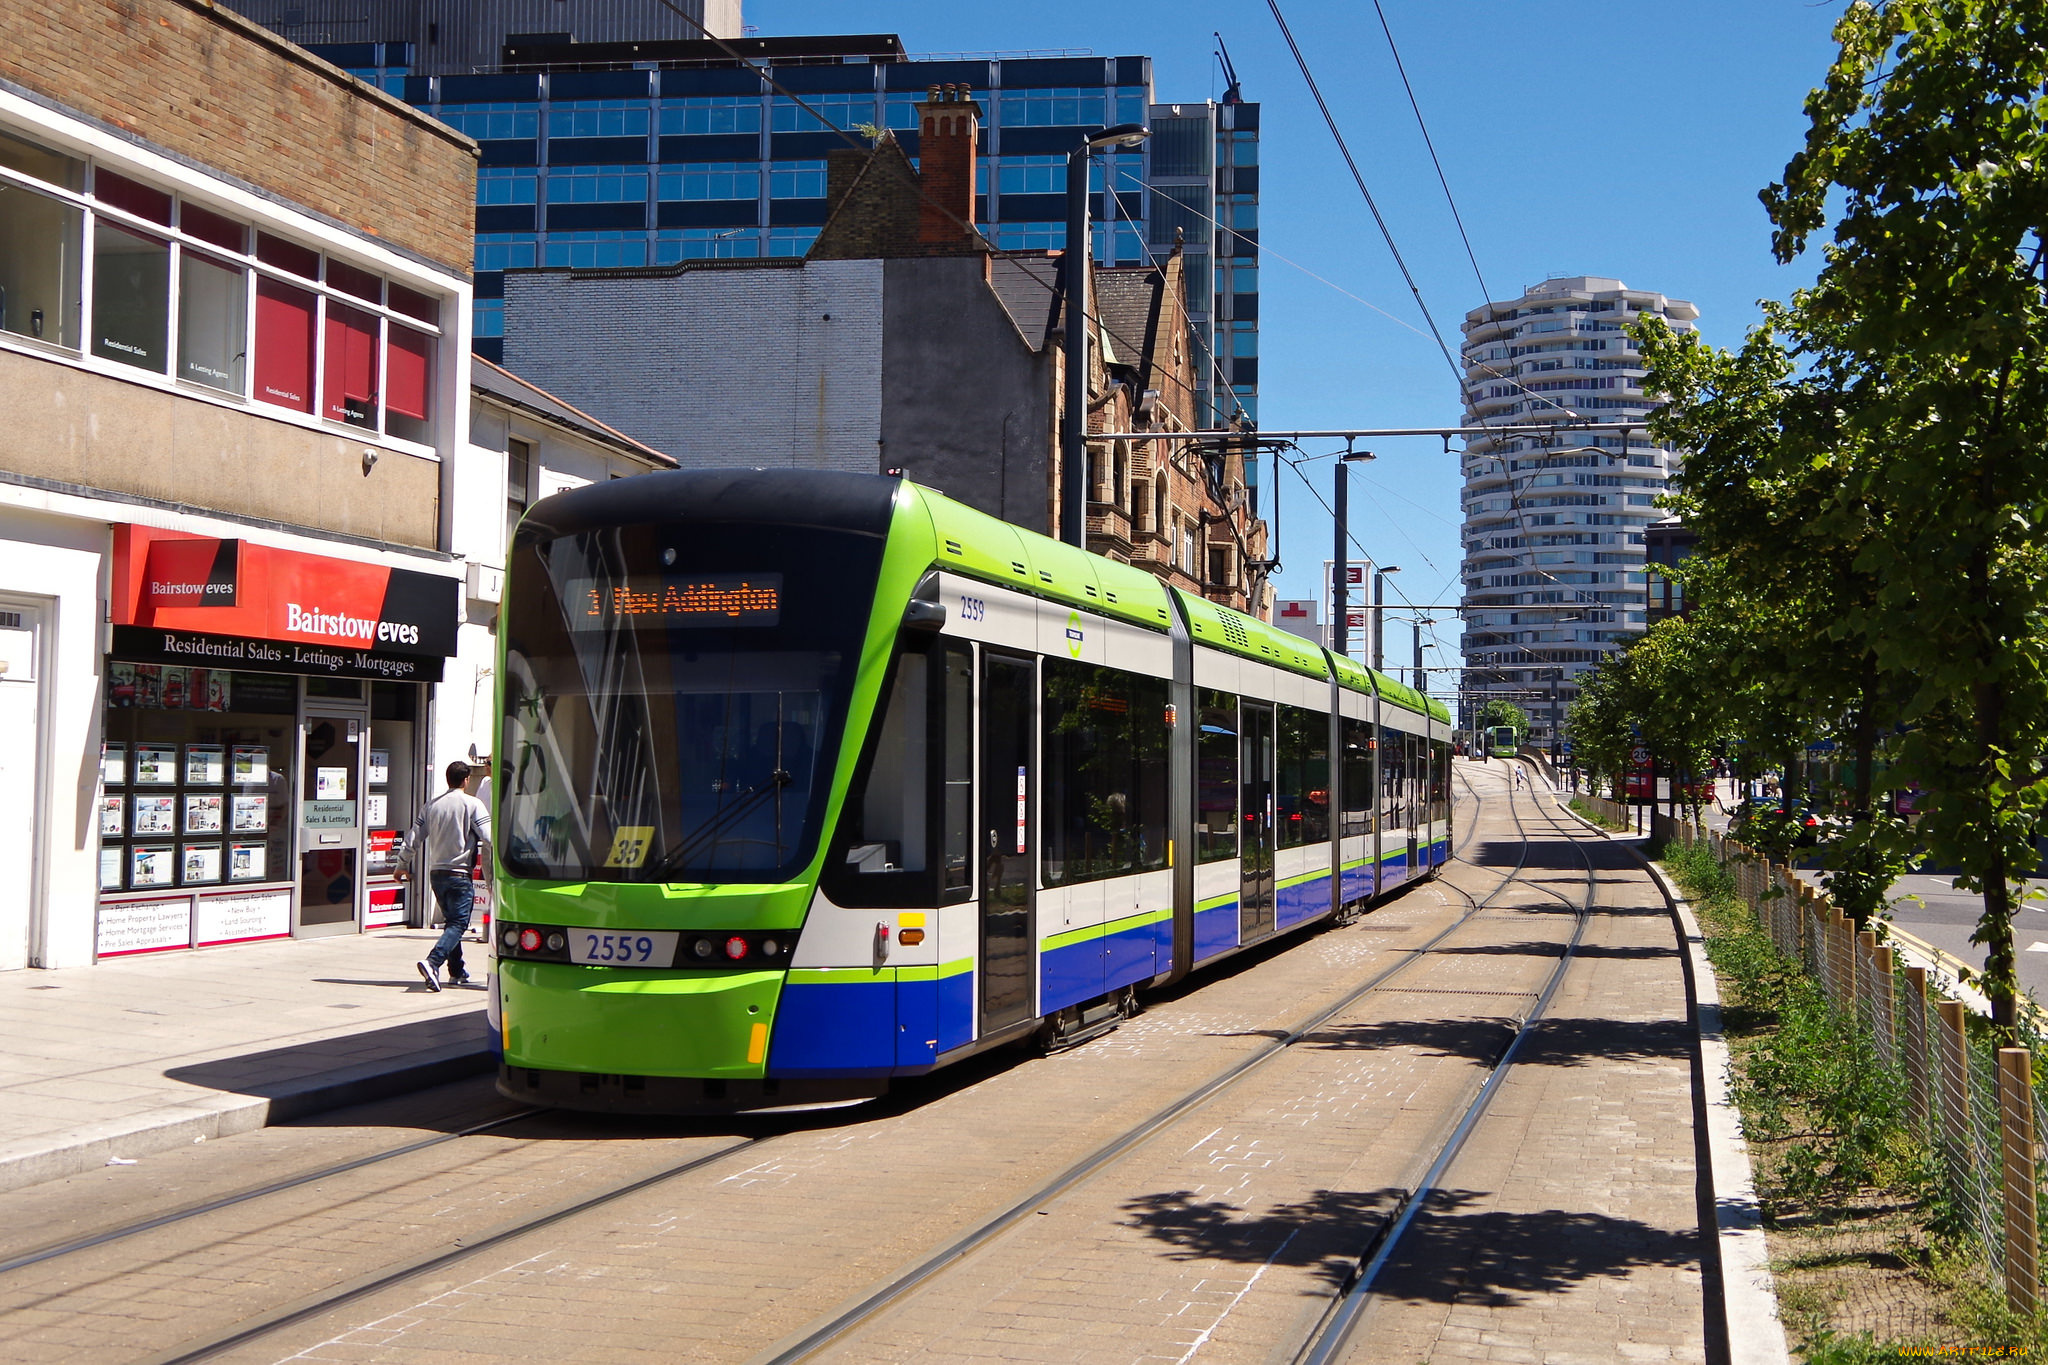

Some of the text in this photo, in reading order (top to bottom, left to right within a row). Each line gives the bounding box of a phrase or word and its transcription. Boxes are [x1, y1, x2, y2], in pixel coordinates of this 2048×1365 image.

[151, 581, 205, 594] Bairstow
[614, 587, 658, 614] New
[662, 582, 777, 616] Addington
[960, 595, 985, 622] 2559
[287, 603, 419, 645] Bairstow eves
[164, 634, 243, 659] Residential
[247, 643, 282, 661] Sales
[293, 647, 344, 670] Lettings
[354, 653, 415, 676] Mortgages
[1634, 751, 1647, 759] 20
[313, 804, 344, 812] Residential
[305, 815, 351, 824] Sales & Lettings
[613, 839, 643, 865] 35
[106, 916, 126, 924] Home
[128, 914, 156, 924] Property
[158, 912, 183, 921] Lawyers
[105, 928, 126, 936] Home
[127, 925, 157, 935] Mortgage
[158, 923, 183, 932] Services
[105, 940, 117, 948] Pre
[118, 938, 134, 947] Sales
[586, 934, 653, 962] 2559
